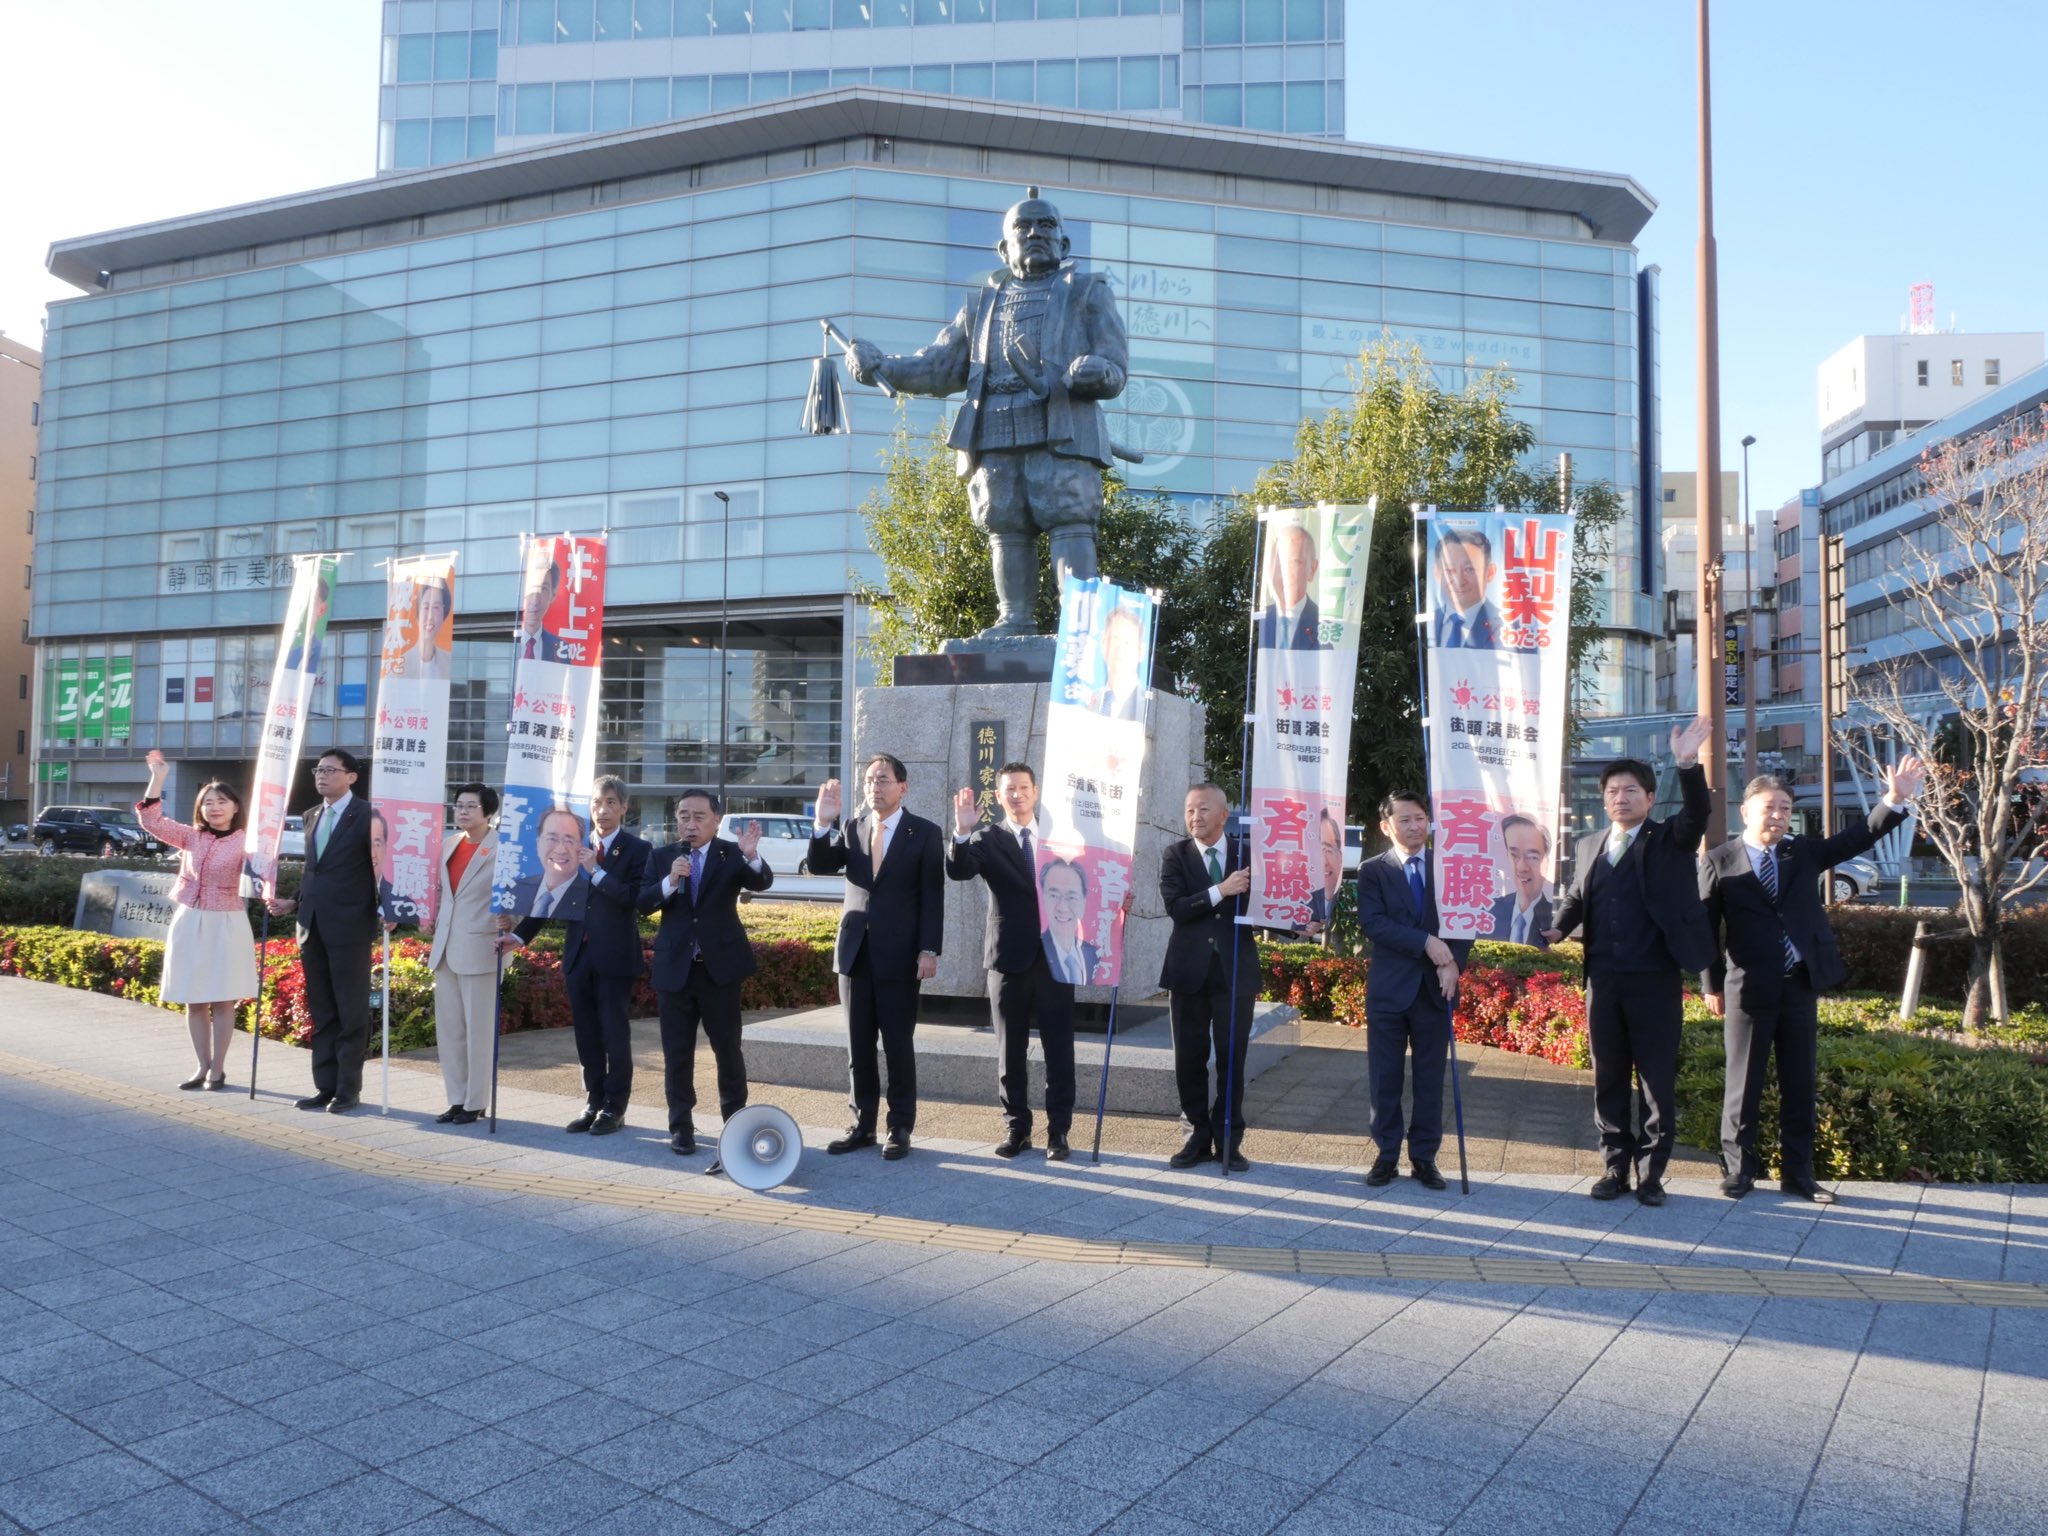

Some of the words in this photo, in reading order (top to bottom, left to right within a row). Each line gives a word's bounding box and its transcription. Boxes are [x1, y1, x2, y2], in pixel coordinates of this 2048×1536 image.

[1503, 519, 1557, 625] 山梨
[557, 545, 592, 640] 井上
[1502, 626, 1552, 648] わたる
[1482, 694, 1541, 716] 公明党
[393, 715, 429, 730] 公明党
[1449, 716, 1539, 743] 街頭演説会
[976, 725, 997, 823] 徳川家康公
[391, 807, 433, 900] 斉藤
[1263, 797, 1313, 903] 斉藤
[1439, 798, 1495, 909] 斉藤
[391, 900, 431, 920] てつお
[1262, 903, 1313, 923] てつお
[1442, 911, 1495, 934] てつお
